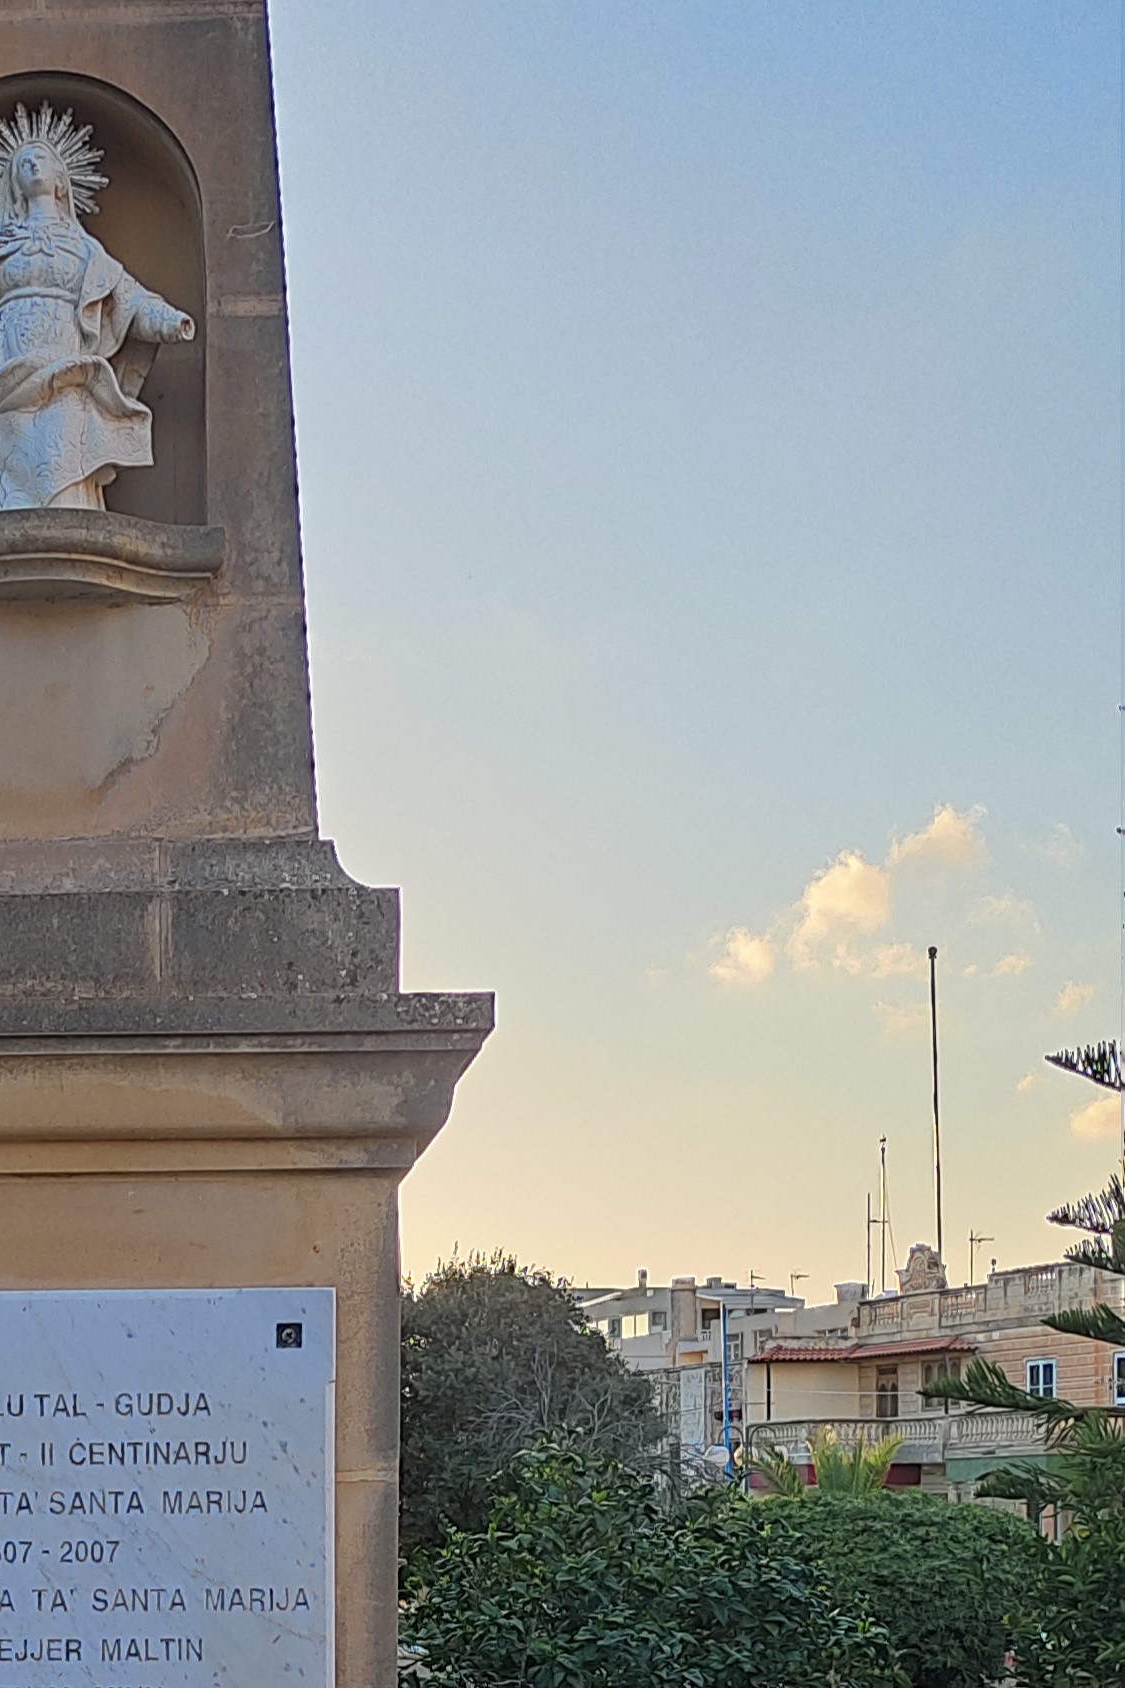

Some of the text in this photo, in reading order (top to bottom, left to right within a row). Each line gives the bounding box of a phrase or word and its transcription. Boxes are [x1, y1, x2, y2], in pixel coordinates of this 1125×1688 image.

[40, 1443, 53, 1467] II
[49, 1491, 145, 1515] SANTA
[162, 1491, 268, 1515] MARIJA
[59, 1542, 121, 1564] 2007
[32, 1589, 76, 1613] TA'
[92, 1589, 187, 1613] SANTA
[204, 1589, 311, 1612] MARIJA
[101, 1638, 204, 1662] MALTIN
